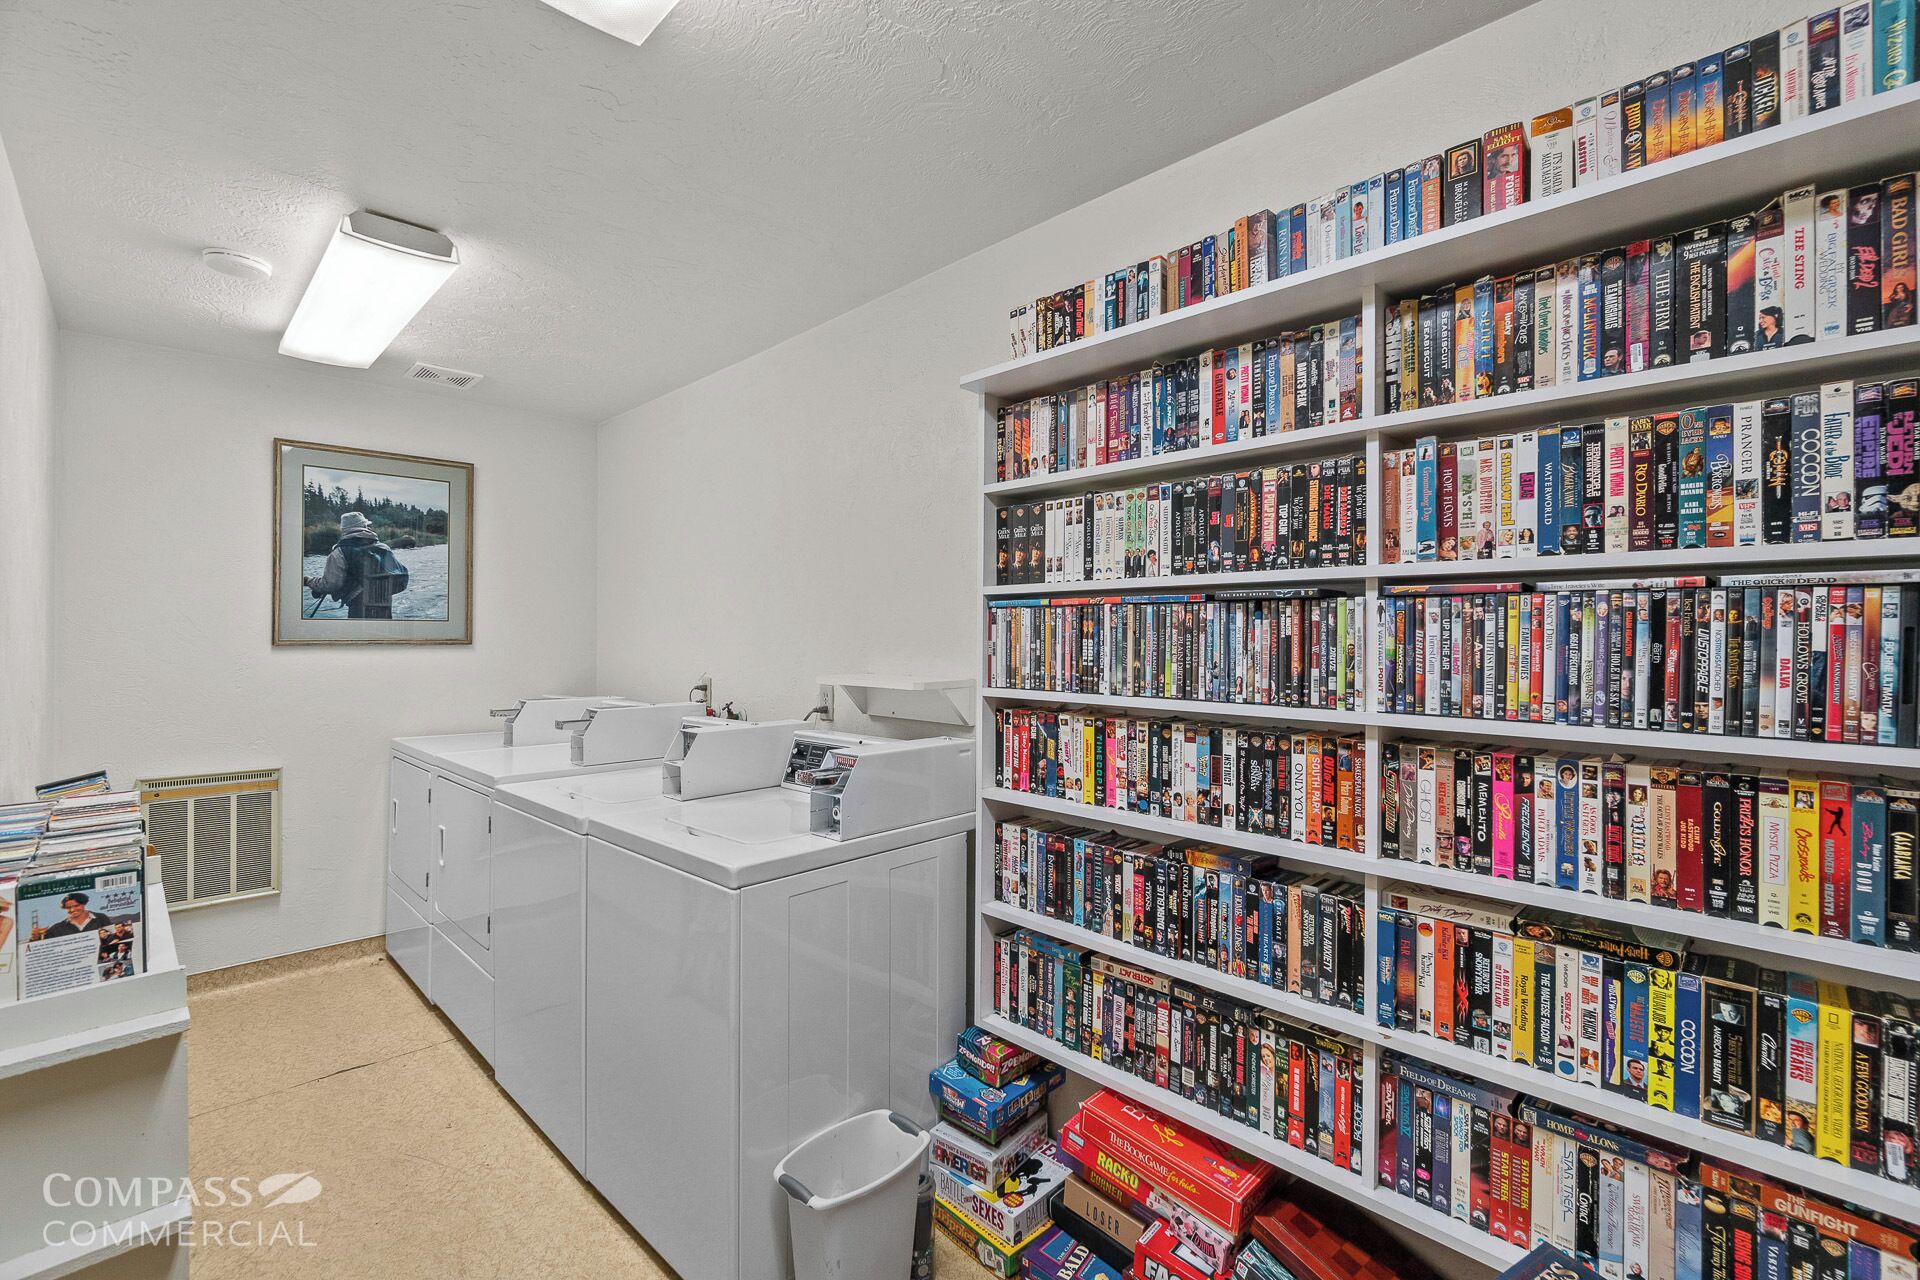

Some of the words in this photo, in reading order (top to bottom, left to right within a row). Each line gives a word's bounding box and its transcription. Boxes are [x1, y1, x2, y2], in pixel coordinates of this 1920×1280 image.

[1891, 196, 1908, 229] BAD
[1684, 238, 1719, 251] WINNER
[1795, 227, 1804, 251] THE
[1795, 254, 1804, 289] STING
[1385, 322, 1401, 382] SHAFT
[1215, 373, 1223, 417] GRAYEAGLE
[1297, 388, 1306, 408] PEAK
[1794, 394, 1818, 406] CBS
[1795, 405, 1818, 416] FOX
[1825, 412, 1850, 438] FATHER
[1742, 416, 1751, 474] PRANCER
[1502, 453, 1511, 500] SHALLOW
[1637, 464, 1647, 481] RIO
[1801, 428, 1820, 497] COCOON
[1825, 455, 1850, 479] BRIDE
[1308, 480, 1319, 510] STRIKING
[1443, 469, 1452, 494] HOPE
[1545, 463, 1553, 525] WATERWORLD
[1263, 494, 1276, 512] PULP
[1279, 504, 1288, 518] TOP
[1443, 498, 1452, 528] FLOATS
[1635, 482, 1647, 516] DIABLO
[1263, 513, 1276, 542] FICTION
[1279, 520, 1287, 535] GUN
[1308, 511, 1319, 542] DISTANCE
[1546, 599, 1554, 627] NANCY
[1683, 599, 1693, 612] Best
[1683, 613, 1693, 636] Friends
[1797, 622, 1810, 669] HOLLOWS
[1884, 642, 1893, 674] BOURNE
[1697, 629, 1708, 693] UNSTOPPABLE
[1780, 658, 1790, 688] DALVA
[1797, 672, 1807, 703] GROVE
[1882, 675, 1892, 717] ULTIMATUM
[1295, 764, 1303, 793] ONLY
[1311, 758, 1319, 786] SOUTH
[1295, 797, 1303, 820] YOU
[1311, 790, 1320, 814] PARK
[1421, 780, 1431, 824] GHOST
[1476, 783, 1488, 842] MEMENTO
[1521, 797, 1530, 860] FREQUENCY
[1769, 822, 1779, 850] MYSTIC
[1740, 838, 1751, 876] HONOR
[1769, 854, 1779, 879] PIZZA
[1795, 828, 1814, 882] Crossroads
[1824, 839, 1834, 873] MARKED
[1890, 833, 1914, 879] CASABLANCA
[1856, 862, 1872, 892] BOON
[1156, 885, 1166, 904] BLUE
[1824, 882, 1834, 916] DEATH
[1156, 905, 1166, 930] DARK
[1420, 905, 1442, 914] Dirty
[1445, 909, 1473, 919] Dancing
[1324, 918, 1332, 937] HIGH
[1599, 940, 1624, 958] Potter
[1625, 946, 1649, 960] Harry
[1119, 968, 1132, 978] ACT
[1132, 972, 1154, 986] SISTER
[1542, 973, 1550, 987] THE
[1203, 998, 1214, 1009] E.T.
[1519, 997, 1528, 1031] Wedding
[1541, 987, 1550, 1020] MALTESE
[1609, 984, 1619, 1023] HOLLYWOOD
[1158, 1008, 1168, 1038] ROCKY
[1540, 1019, 1550, 1044] FALCON
[1582, 1010, 1598, 1042] MEXICAN
[1681, 1019, 1695, 1074] COCOON
[1714, 1025, 1722, 1059] AMERICAN
[1805, 1042, 1814, 1058] EIGHT
[1539, 1056, 1552, 1064] VHS
[1790, 1038, 1805, 1081] FREAKS
[1832, 1042, 1844, 1072] NATIONAL
[1857, 1061, 1869, 1080] FEW
[1400, 1066, 1426, 1083] FIELD
[1437, 1079, 1477, 1101] DREAMS
[1713, 1061, 1721, 1085] BEAUTY
[1805, 1061, 1814, 1084] LEGGED
[1832, 1075, 1844, 1116] GEOGRAPHIC
[1856, 1080, 1869, 1108] GOOD
[1546, 1120, 1575, 1136] HOME
[1855, 1108, 1869, 1132] MEN
[1109, 1130, 1124, 1148] THE
[1124, 1141, 1146, 1162] BOOK
[1145, 1156, 1168, 1174] GAME
[1500, 1152, 1509, 1174] STAR
[1521, 1160, 1530, 1182] STAR
[940, 1171, 965, 1197] BATTLE
[973, 1193, 1004, 1231] SEXES
[1499, 1178, 1508, 1201] TREK
[1520, 1185, 1528, 1209] TREK
[1787, 1194, 1805, 1207] THE
[1086, 1202, 1120, 1236] LOSER
[1774, 1199, 1858, 1236] GUNFIGHT
[1057, 1247, 1088, 1279] BALD
